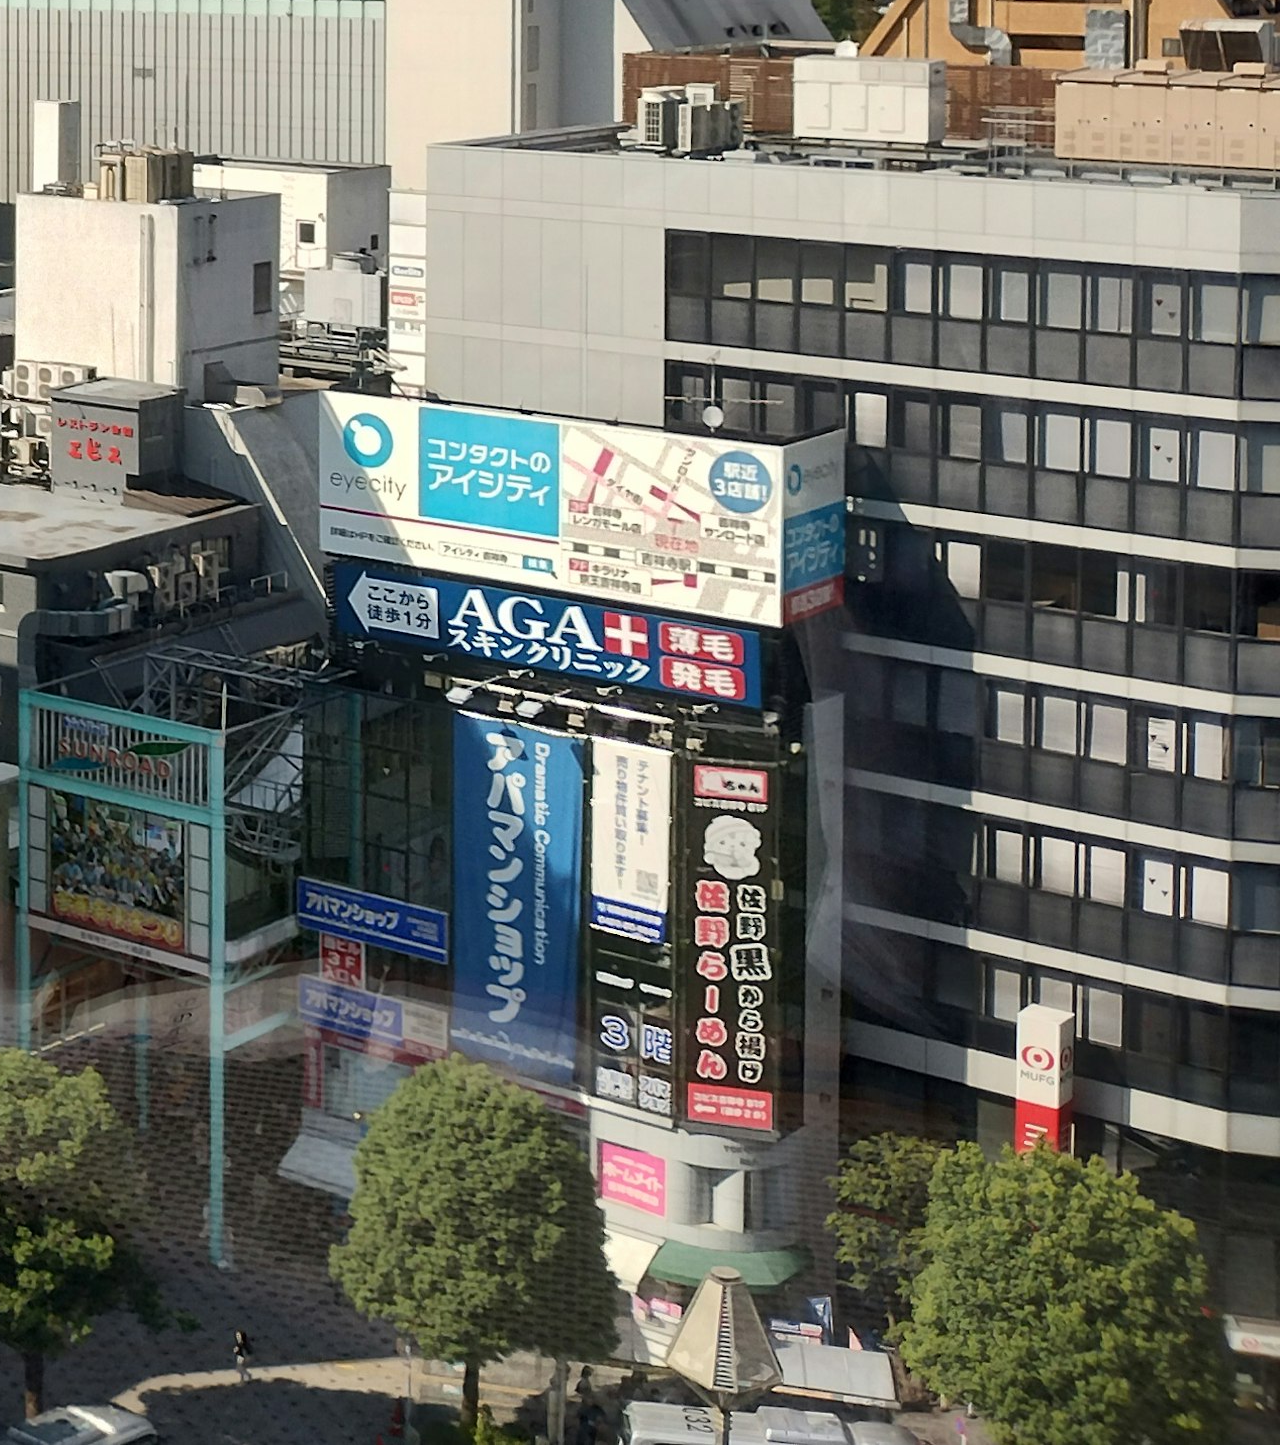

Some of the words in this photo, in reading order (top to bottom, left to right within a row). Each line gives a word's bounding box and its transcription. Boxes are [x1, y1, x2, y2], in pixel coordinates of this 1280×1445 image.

[68, 436, 122, 466] エビス
[428, 438, 552, 474] コンタクトの
[329, 471, 407, 501] eyecity
[428, 463, 552, 506] アイシティ
[723, 461, 759, 482] 駅近
[592, 506, 622, 519] 吉祥寺
[654, 534, 700, 553] 現在地
[592, 564, 630, 578] キラリナ
[367, 585, 431, 610] ここから
[366, 604, 433, 630] 徒歩1分
[447, 588, 604, 653] AGA
[447, 627, 651, 684] スキンクリニック
[668, 626, 736, 663] 薄毛
[670, 661, 738, 696] 発毛
[59, 736, 173, 779] SUNROAD
[534, 742, 551, 826] Dramatic
[486, 732, 527, 1023] アパマンショップ
[305, 890, 399, 930] アパマンショップ
[533, 830, 551, 966] Communication
[322, 965, 349, 984] 入口
[328, 952, 356, 969] 3F
[305, 988, 396, 1027] アパマンショップ
[1020, 1070, 1056, 1086] MUFG
